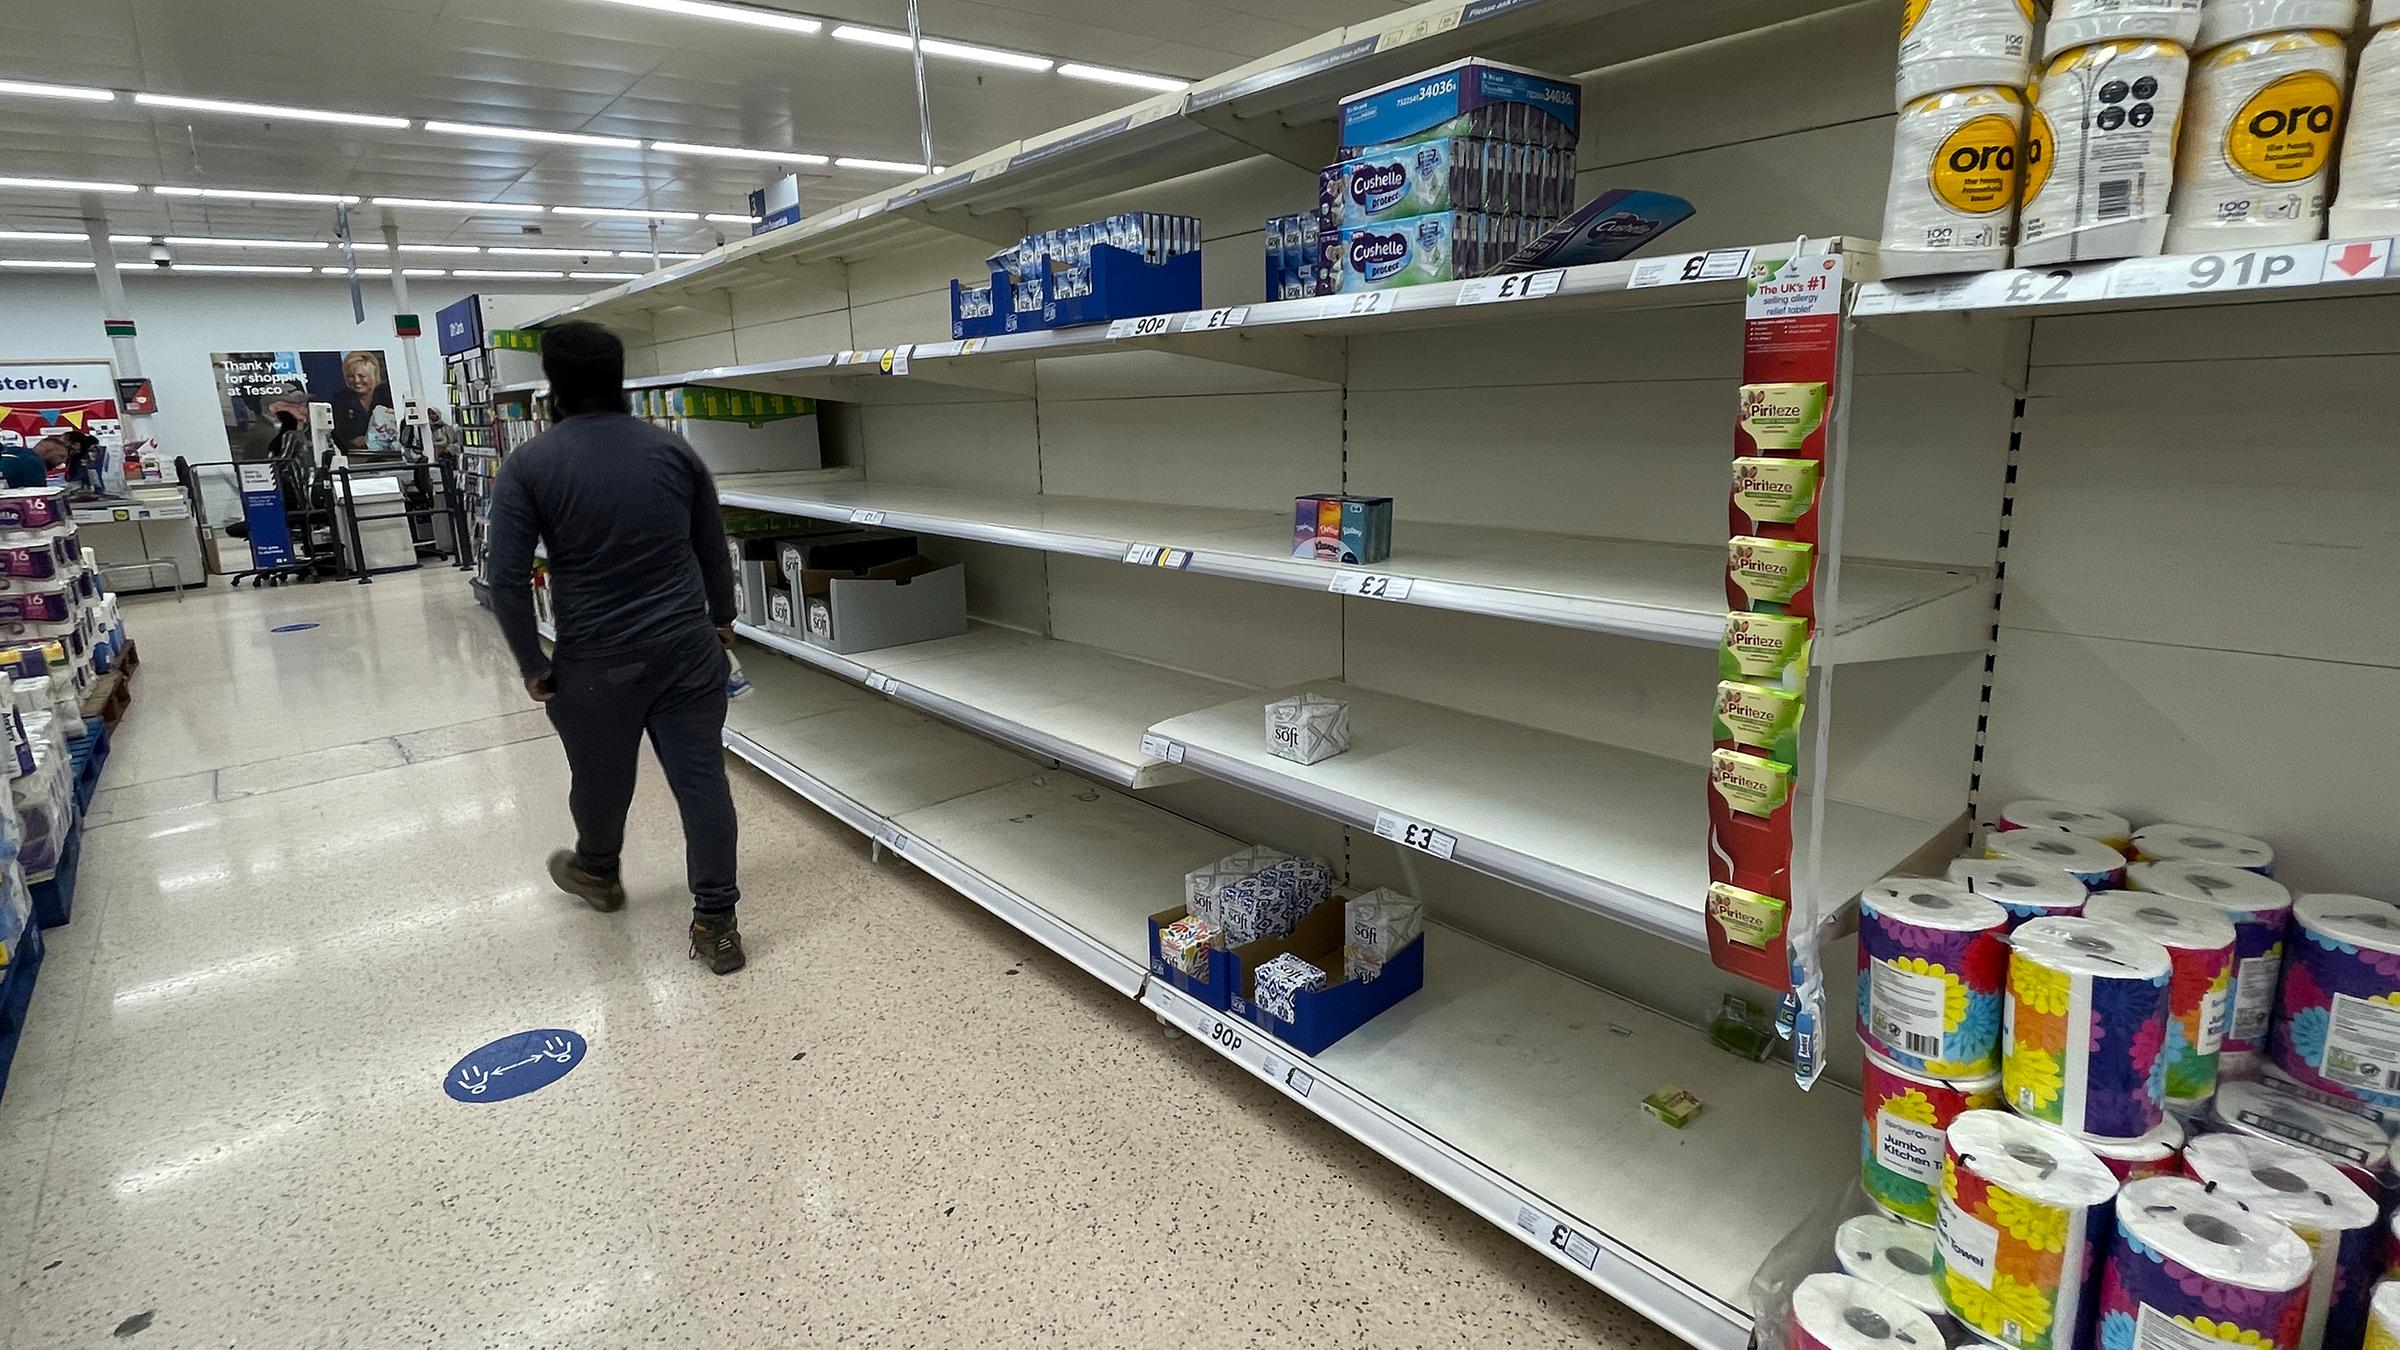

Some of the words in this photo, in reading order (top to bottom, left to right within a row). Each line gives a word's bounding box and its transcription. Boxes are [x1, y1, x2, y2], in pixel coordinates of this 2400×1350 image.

[2249, 105, 2333, 138] ora
[1949, 146, 2014, 172] ora
[1354, 171, 1403, 195] Cushelle
[1372, 192, 1400, 209] protect
[1353, 240, 1404, 262] Cushelle
[1372, 262, 1400, 277] protect
[2187, 252, 2294, 289] 91p
[1498, 275, 1532, 298] £1
[1760, 285, 1778, 295] The
[1781, 282, 1804, 293] UK's
[1808, 275, 1827, 291] #1
[2003, 269, 2073, 302] £2
[1350, 292, 1380, 314] £2
[1763, 294, 1789, 305] selling
[1791, 293, 1819, 304] allergy
[1208, 308, 1232, 328] £1
[1767, 306, 1786, 316] relief
[1135, 317, 1165, 335] 90p
[221, 360, 263, 372] Thank
[266, 360, 290, 372] you
[224, 372, 246, 384] for
[248, 371, 309, 385] shopping
[228, 386, 242, 396] at
[243, 384, 283, 396] Tesco
[1751, 404, 1800, 417] Piriteze
[1743, 479, 1793, 493] Piriteze
[26, 498, 46, 511] 16
[11, 550, 30, 561] 16
[1740, 558, 1788, 575] Piriteze
[1359, 575, 1388, 597] £2
[26, 594, 44, 606] 16
[812, 613, 828, 636] soft
[1736, 633, 1783, 648] Piriteze
[1728, 702, 1775, 721] Piriteze
[1274, 726, 1299, 748] soft
[1722, 771, 1768, 792] Piriteze
[1404, 823, 1432, 850] £3
[1193, 895, 1213, 913] soft
[1228, 910, 1248, 930] soft
[1719, 904, 1764, 926] Piriteze
[1353, 923, 1378, 945] soft
[1211, 1022, 1242, 1051] 90p
[1884, 1133, 1927, 1156] Jumbo
[1884, 1143, 1931, 1168] Kitchen
[1950, 1236, 1984, 1268] Towel
